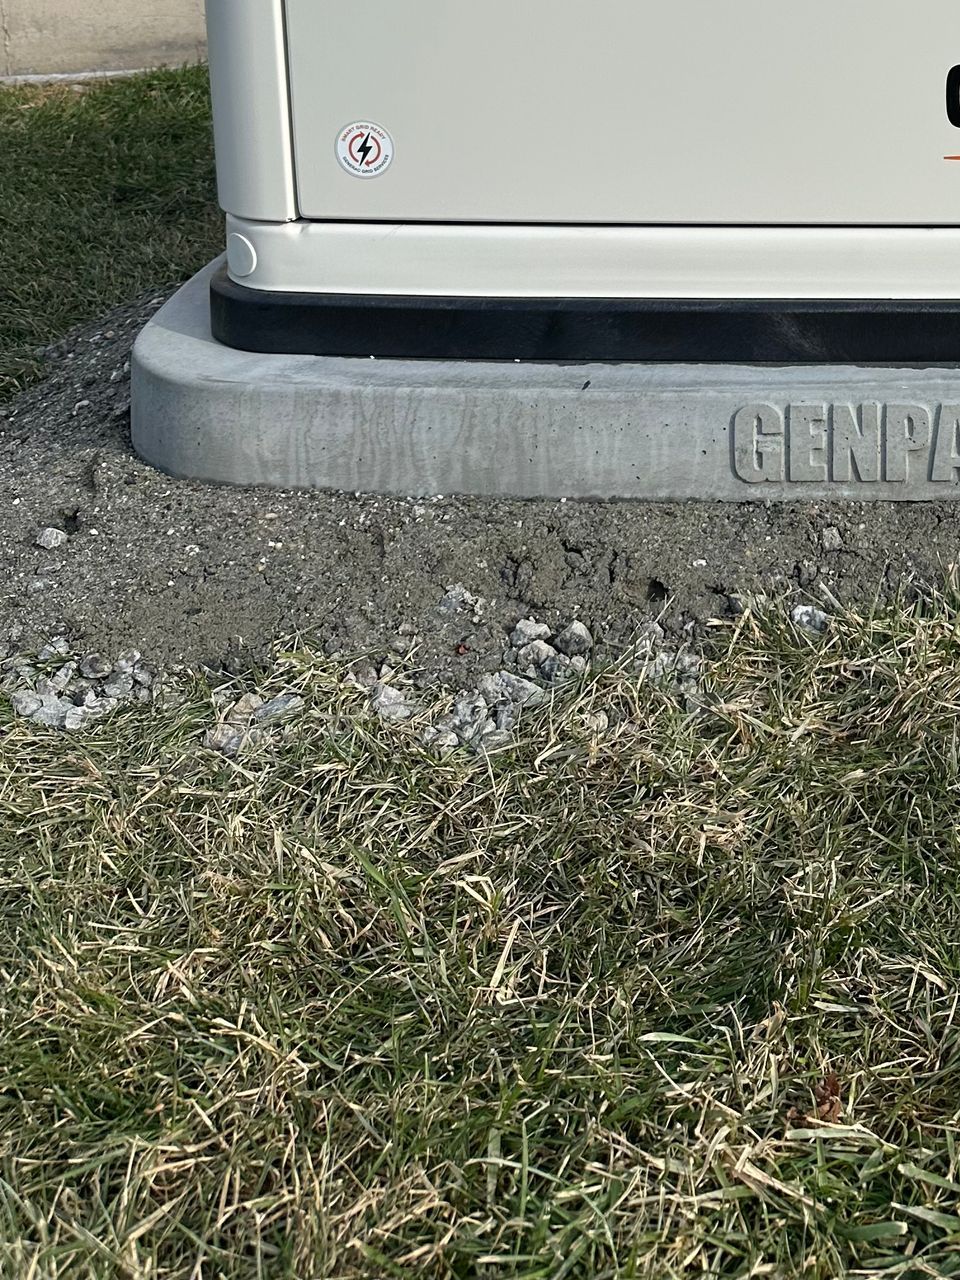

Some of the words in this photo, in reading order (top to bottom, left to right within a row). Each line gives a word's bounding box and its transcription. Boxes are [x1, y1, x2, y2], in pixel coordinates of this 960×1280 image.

[341, 127, 355, 141] SMART
[370, 126, 386, 139] READY
[343, 156, 360, 172] GENERAC
